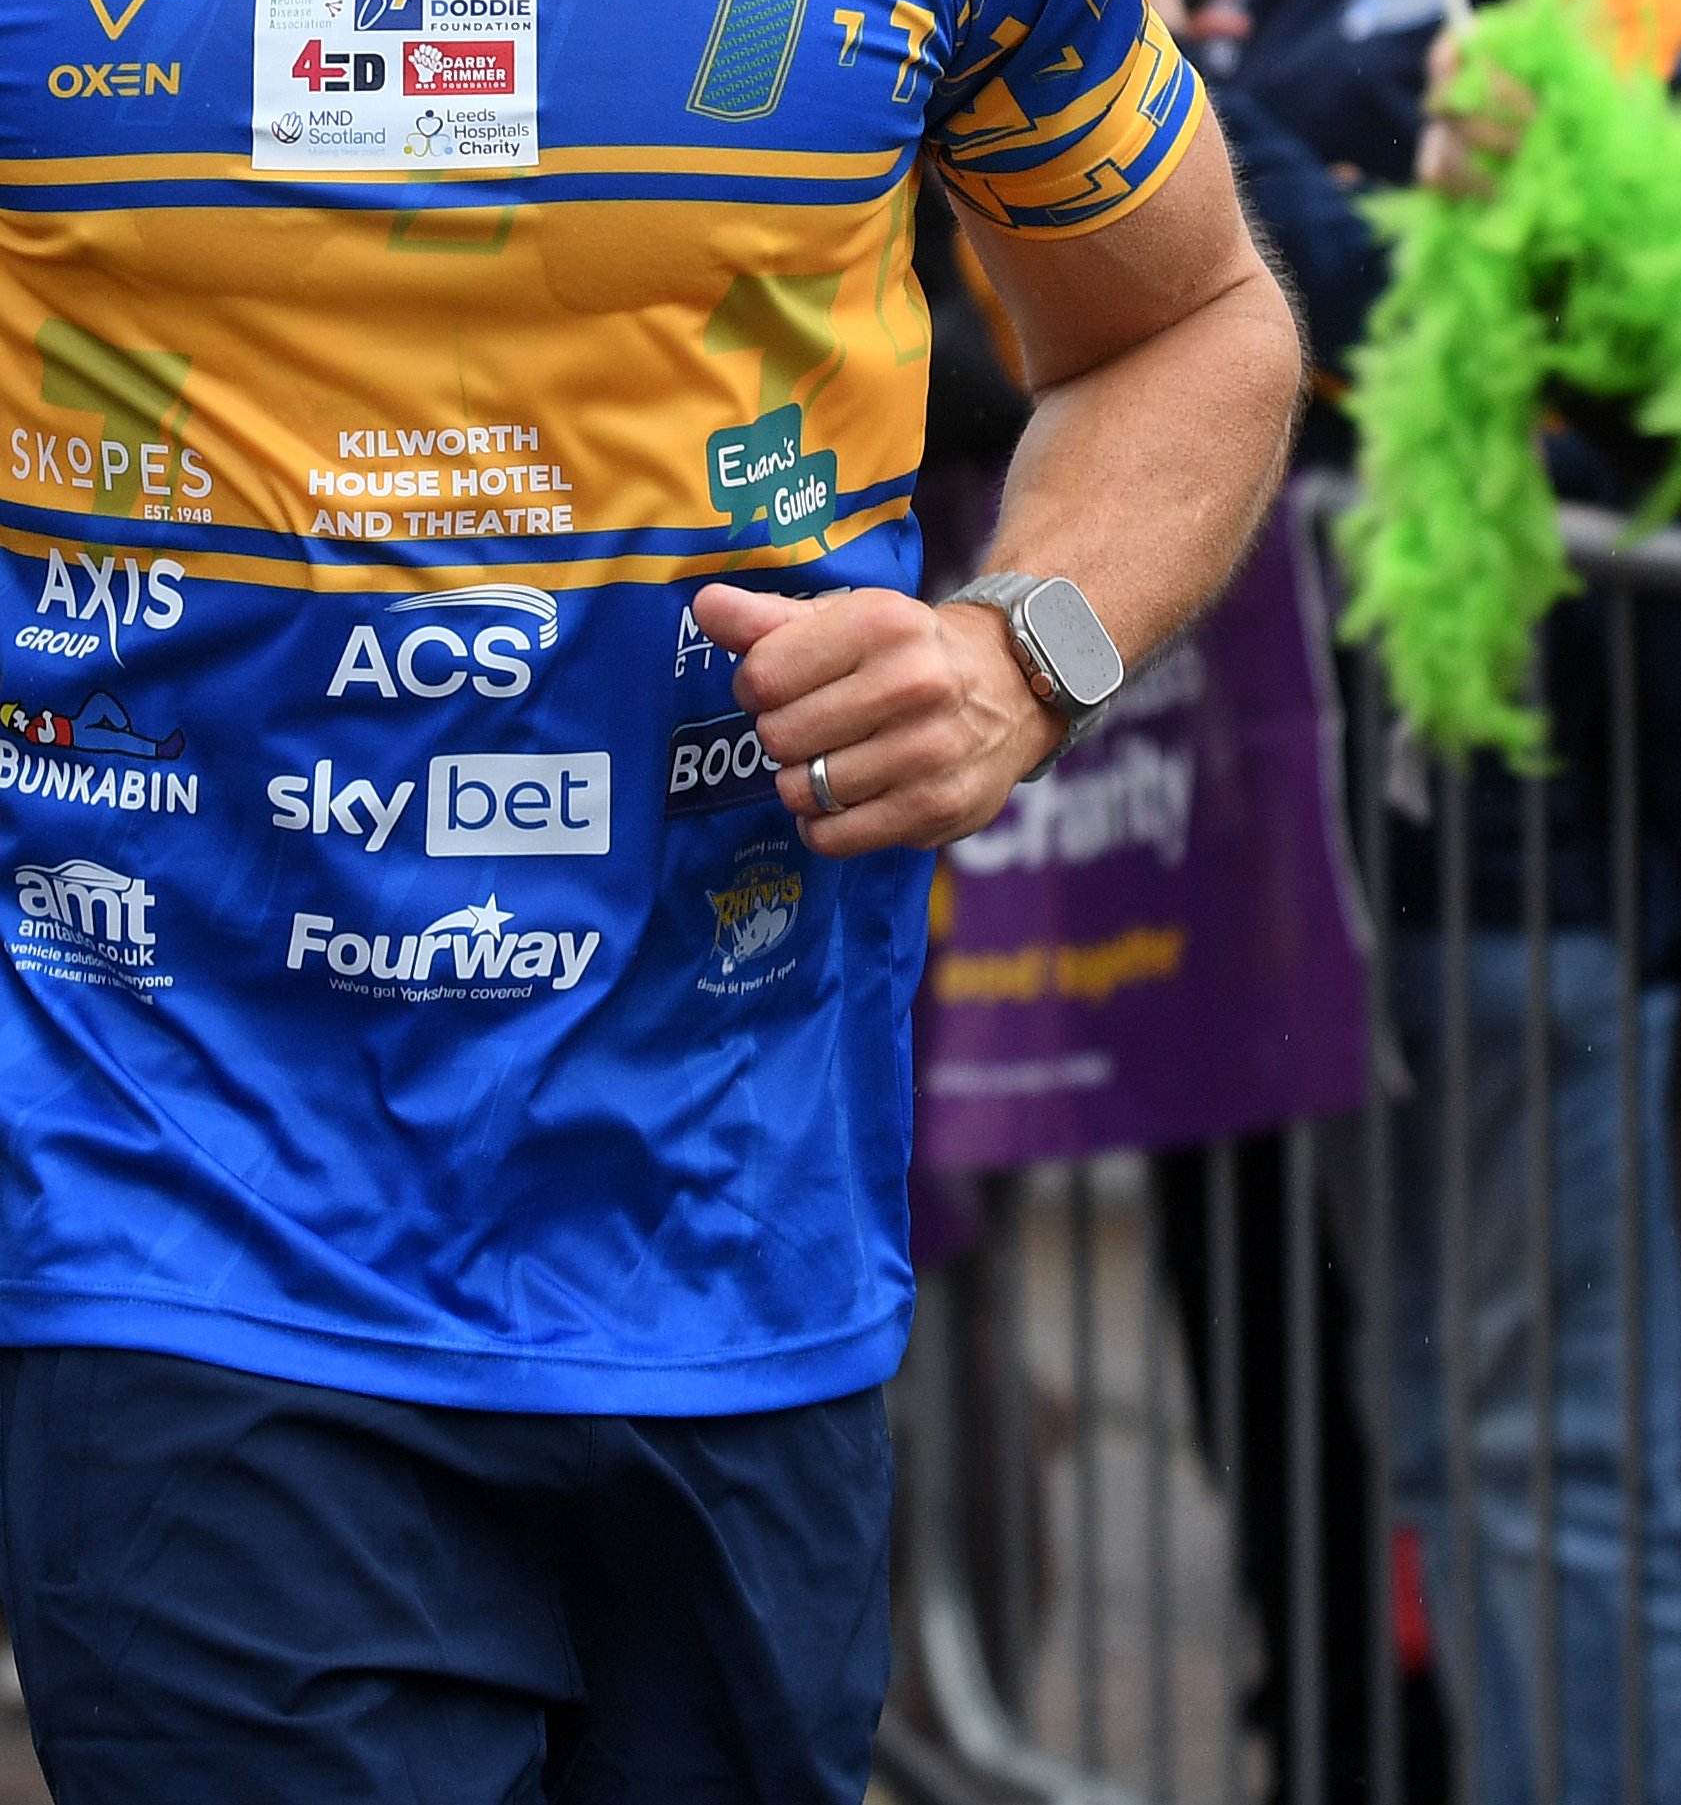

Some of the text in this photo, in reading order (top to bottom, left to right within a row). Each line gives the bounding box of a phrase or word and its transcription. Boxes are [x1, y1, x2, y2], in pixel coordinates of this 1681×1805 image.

[270, 7, 312, 17] Disease
[431, 0, 531, 16] DODDIE
[269, 19, 332, 29] Association
[431, 22, 531, 32] FOUNDATION
[292, 39, 385, 92] 4ED
[443, 56, 497, 68] DARBY
[443, 69, 506, 81] RIMMER
[48, 62, 181, 98] OXEN
[309, 109, 354, 126] MND
[447, 108, 497, 123] Leeds
[309, 127, 386, 145] Scotland
[454, 122, 530, 141] Hospitals
[459, 139, 520, 157] Charity
[338, 425, 538, 458] KILWORTH
[11, 427, 213, 498] SKOPES
[718, 436, 796, 488] Euan's
[308, 465, 573, 497] HOUSE HOTEL
[774, 474, 828, 526] Guide
[144, 504, 213, 523] EST. 1948
[310, 504, 575, 538] AND THEATRE
[36, 548, 186, 668] AXIS
[15, 625, 101, 659] GROUP
[325, 625, 532, 699] ACS
[267, 759, 593, 853] sky bet
[15, 870, 157, 945] amt
[11, 943, 62, 961] vehicle
[286, 912, 601, 991] Fourway
[49, 966, 83, 982] LEASE
[87, 973, 107, 986] BUY
[329, 977, 534, 1003] We've got Yorkshire covered
